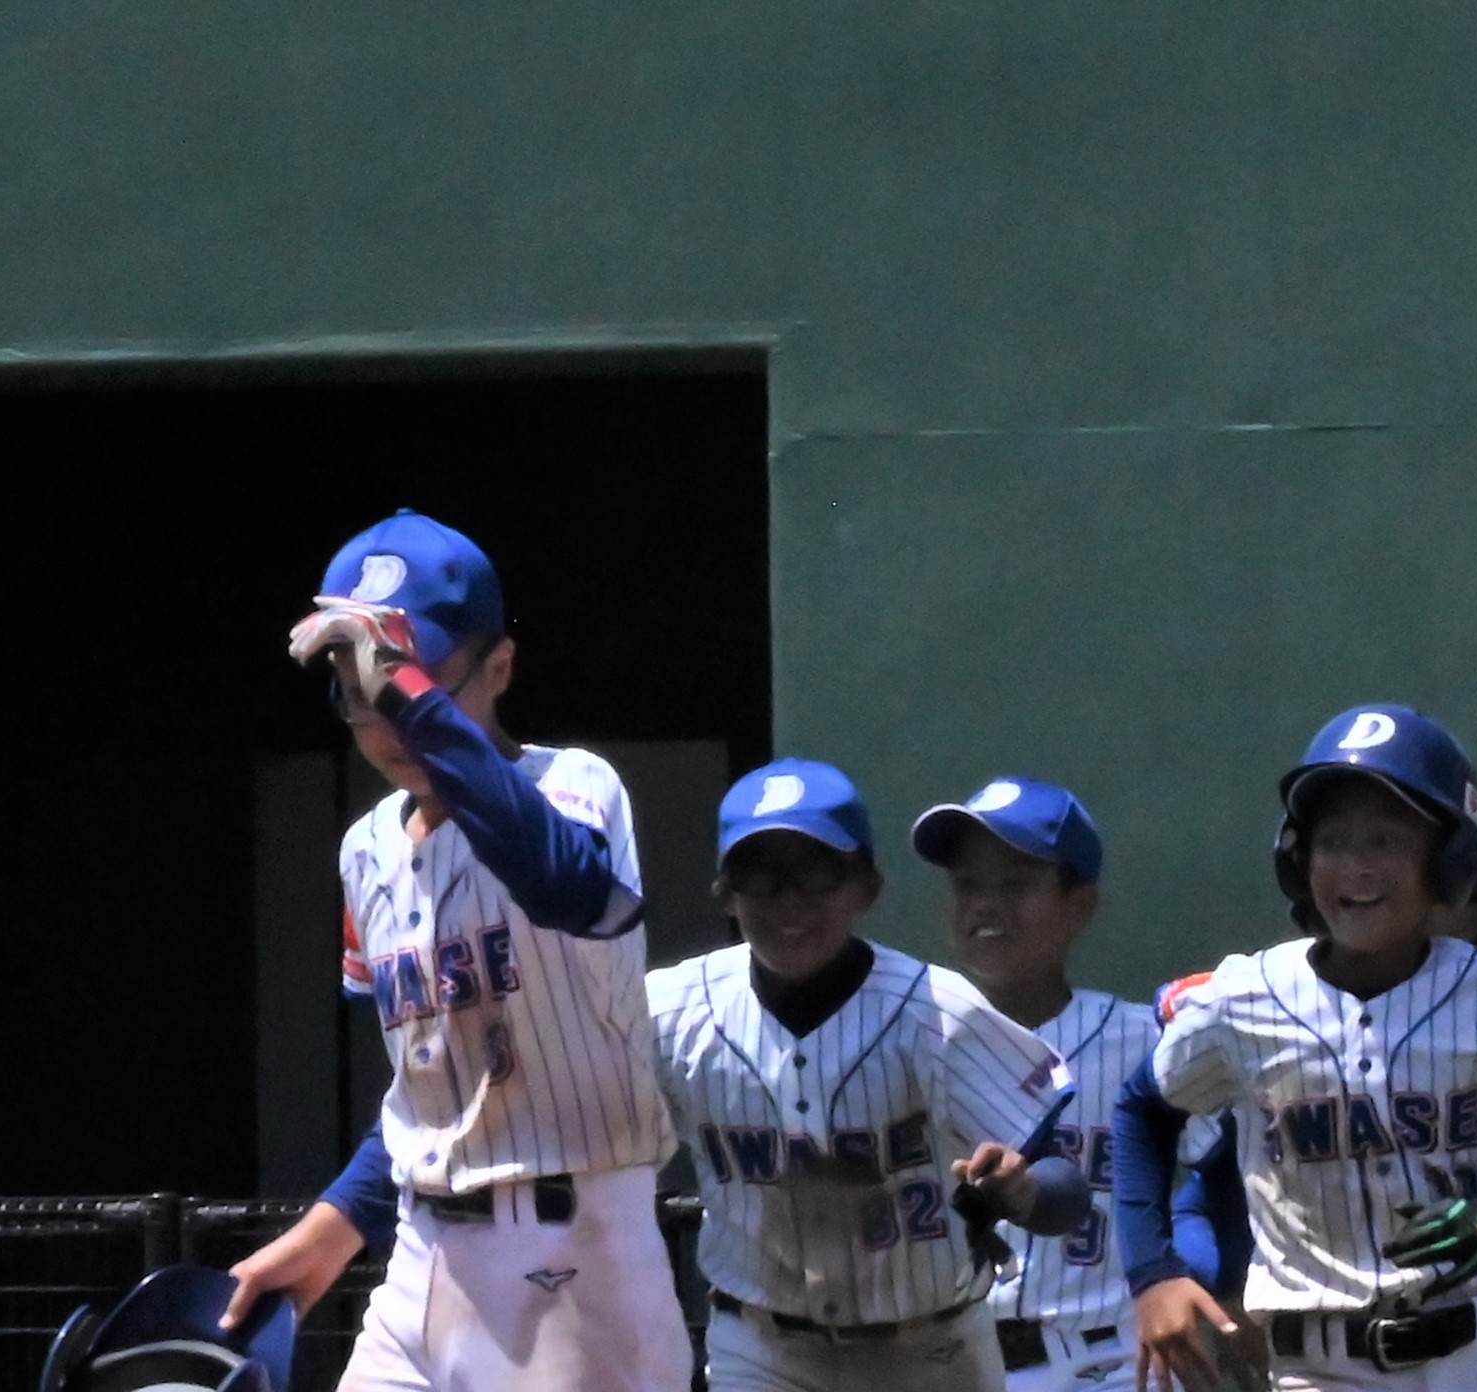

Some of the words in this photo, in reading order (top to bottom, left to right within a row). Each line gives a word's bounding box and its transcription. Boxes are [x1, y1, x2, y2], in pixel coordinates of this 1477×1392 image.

[350, 554, 408, 602] D
[1338, 712, 1396, 749] D
[753, 775, 805, 817] D
